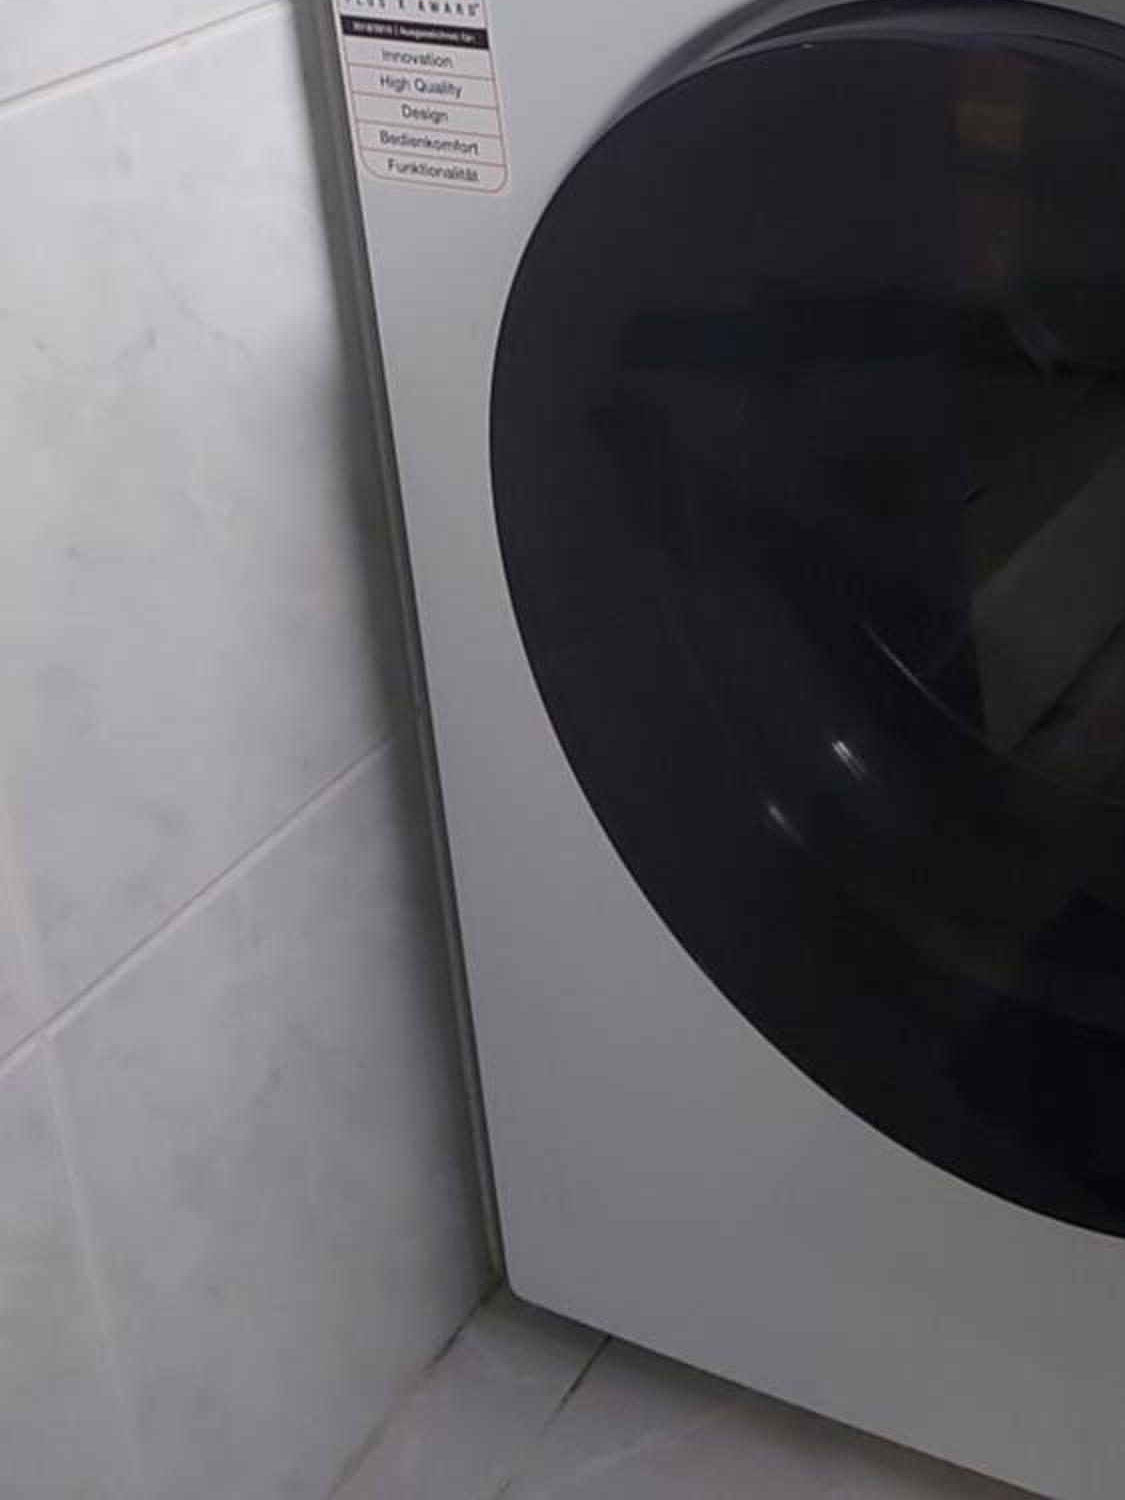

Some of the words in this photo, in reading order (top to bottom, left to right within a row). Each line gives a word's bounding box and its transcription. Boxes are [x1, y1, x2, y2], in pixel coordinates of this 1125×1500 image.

[381, 49, 454, 70] Innovation
[379, 75, 411, 95] High
[413, 78, 464, 102] Quality
[401, 104, 449, 125] Design
[379, 129, 480, 157] Bedienkomfort
[388, 158, 480, 184] Funktionalität
